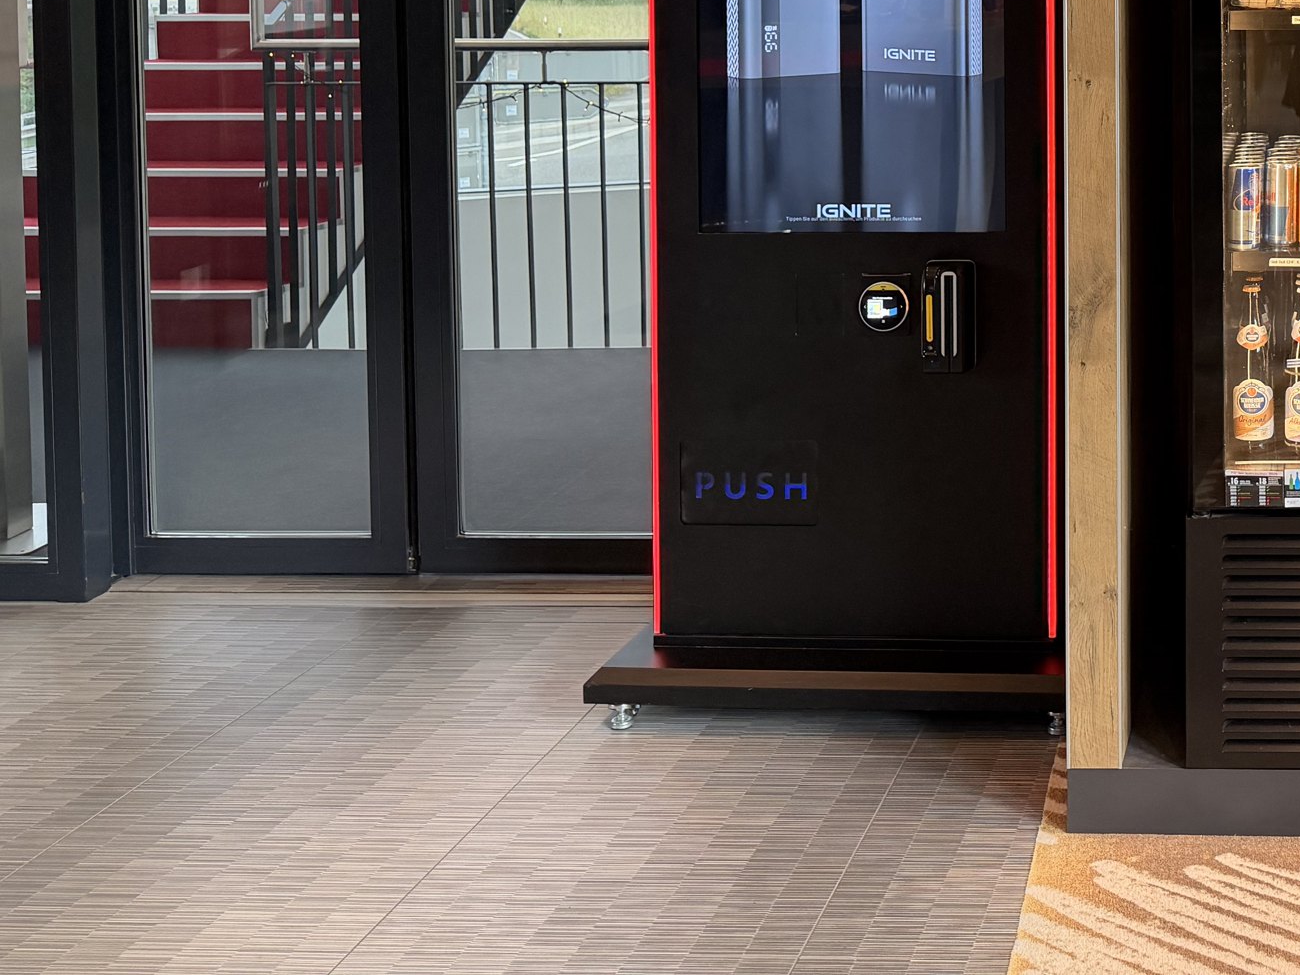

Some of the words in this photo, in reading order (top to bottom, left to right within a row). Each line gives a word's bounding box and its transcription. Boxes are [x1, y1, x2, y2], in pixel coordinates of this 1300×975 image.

[883, 47, 936, 62] IGNITE
[816, 204, 891, 218] IGNITE
[1239, 414, 1267, 426] Original
[695, 471, 808, 500] PUSH
